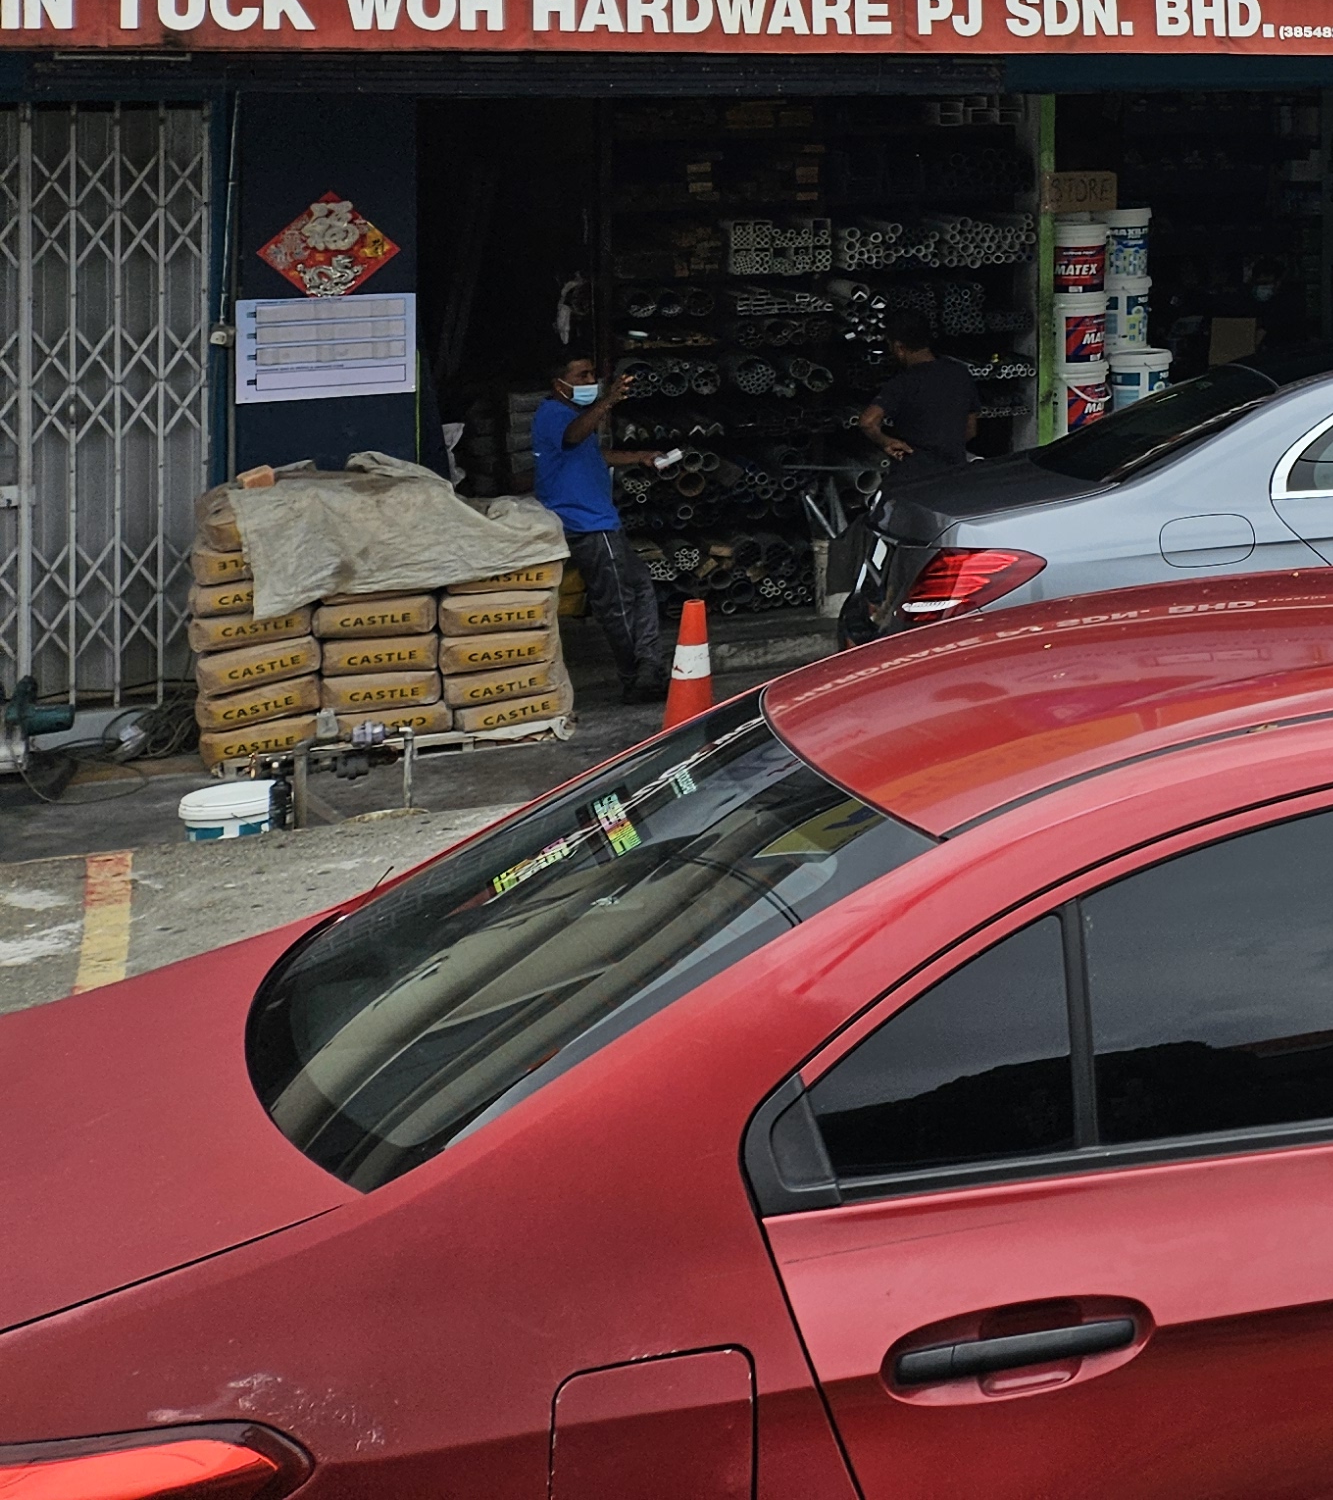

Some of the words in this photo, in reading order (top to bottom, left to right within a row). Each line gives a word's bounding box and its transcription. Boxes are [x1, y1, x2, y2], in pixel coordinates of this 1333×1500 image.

[1051, 179, 1113, 202] STORE
[1055, 264, 1097, 276] MATEX
[339, 612, 411, 628] CASTLE
[468, 647, 536, 662] CASTLE
[228, 655, 300, 680] CASTLE
